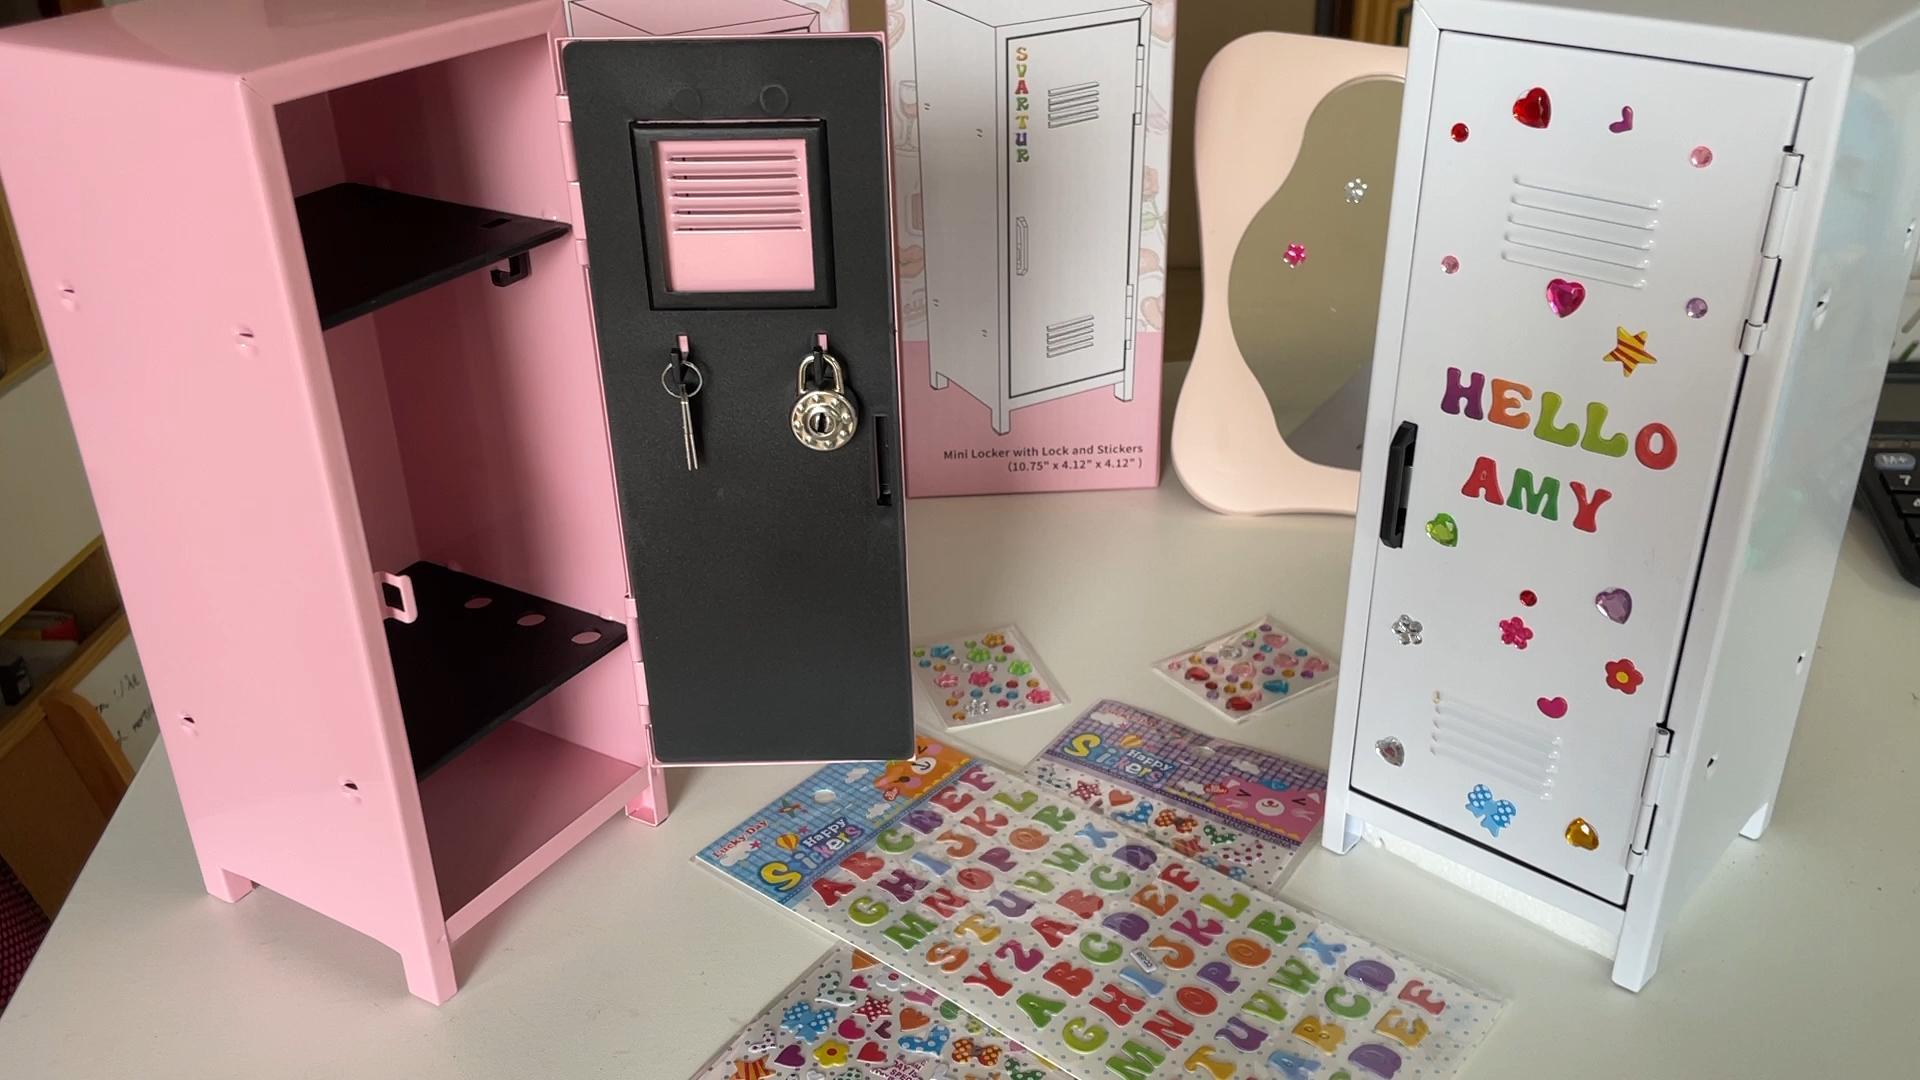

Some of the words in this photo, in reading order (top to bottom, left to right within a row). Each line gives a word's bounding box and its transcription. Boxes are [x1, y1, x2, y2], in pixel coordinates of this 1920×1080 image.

[1015, 46, 1030, 163] SVARTUR
[1440, 366, 1678, 471] HELLO
[943, 450, 968, 460] Mini
[971, 448, 1010, 460] Locker
[1012, 447, 1039, 458] with
[1041, 446, 1069, 457] Lock
[1072, 445, 1094, 456] and
[1096, 444, 1144, 455] Stickers
[1061, 459, 1092, 470] 4.12"
[1461, 456, 1613, 534] AMY
[1899, 474, 1912, 486] 7
[1062, 733, 1164, 783] Sickers
[1126, 748, 1174, 772] Happy
[711, 833, 748, 859] Lucky
[745, 819, 769, 838] Day
[802, 818, 847, 848] Happy
[812, 878, 856, 907] A
[839, 852, 885, 881] B
[877, 828, 914, 854] C
[899, 809, 944, 834] D
[931, 786, 973, 813] E
[959, 766, 996, 792] F
[760, 826, 861, 891] Sickers
[848, 895, 889, 927] G
[877, 869, 928, 903] H
[911, 852, 951, 876] I
[937, 830, 977, 858] J
[960, 806, 1009, 837] K
[993, 789, 1038, 812] L
[883, 913, 938, 950] M
[921, 888, 969, 919] N
[956, 867, 994, 890] O
[978, 847, 1017, 872] P
[1032, 805, 1077, 832] R
[926, 942, 969, 973] S
[954, 913, 1001, 944] T
[988, 891, 1034, 918] U
[1014, 871, 1055, 895] V
[1042, 843, 1089, 873] W
[1074, 822, 1118, 849] X
[1199, 892, 1251, 921] L
[963, 962, 1013, 997] Y
[1031, 916, 1078, 949] A
[1056, 888, 1104, 920] B
[1090, 865, 1131, 892] C
[1112, 845, 1157, 871] D
[1170, 910, 1224, 947] K
[1016, 992, 1067, 1030] A
[1043, 960, 1094, 997] B
[1080, 932, 1123, 966] C
[1102, 911, 1150, 942] D
[1130, 884, 1179, 917] E
[1158, 862, 1201, 893] F
[1149, 934, 1195, 970] J
[1300, 931, 1347, 967] X
[1119, 965, 1165, 997] I
[1268, 957, 1320, 997] W
[1344, 959, 1396, 993] D
[1089, 983, 1146, 1028] H
[1105, 1039, 1166, 1080] M
[1142, 1008, 1194, 1050] N
[1176, 985, 1218, 1017] O
[1197, 961, 1241, 994] P
[1247, 911, 1297, 945] R
[1241, 990, 1288, 1024] V
[1324, 985, 1372, 1020] C
[1397, 979, 1446, 1016] F
[1060, 1016, 1109, 1056] G
[1214, 1016, 1269, 1053] U
[1291, 1014, 1346, 1056] B
[1375, 1008, 1429, 1050] E
[1184, 1044, 1238, 1080] T
[1268, 1049, 1321, 1080] A
[1348, 1044, 1402, 1080] D
